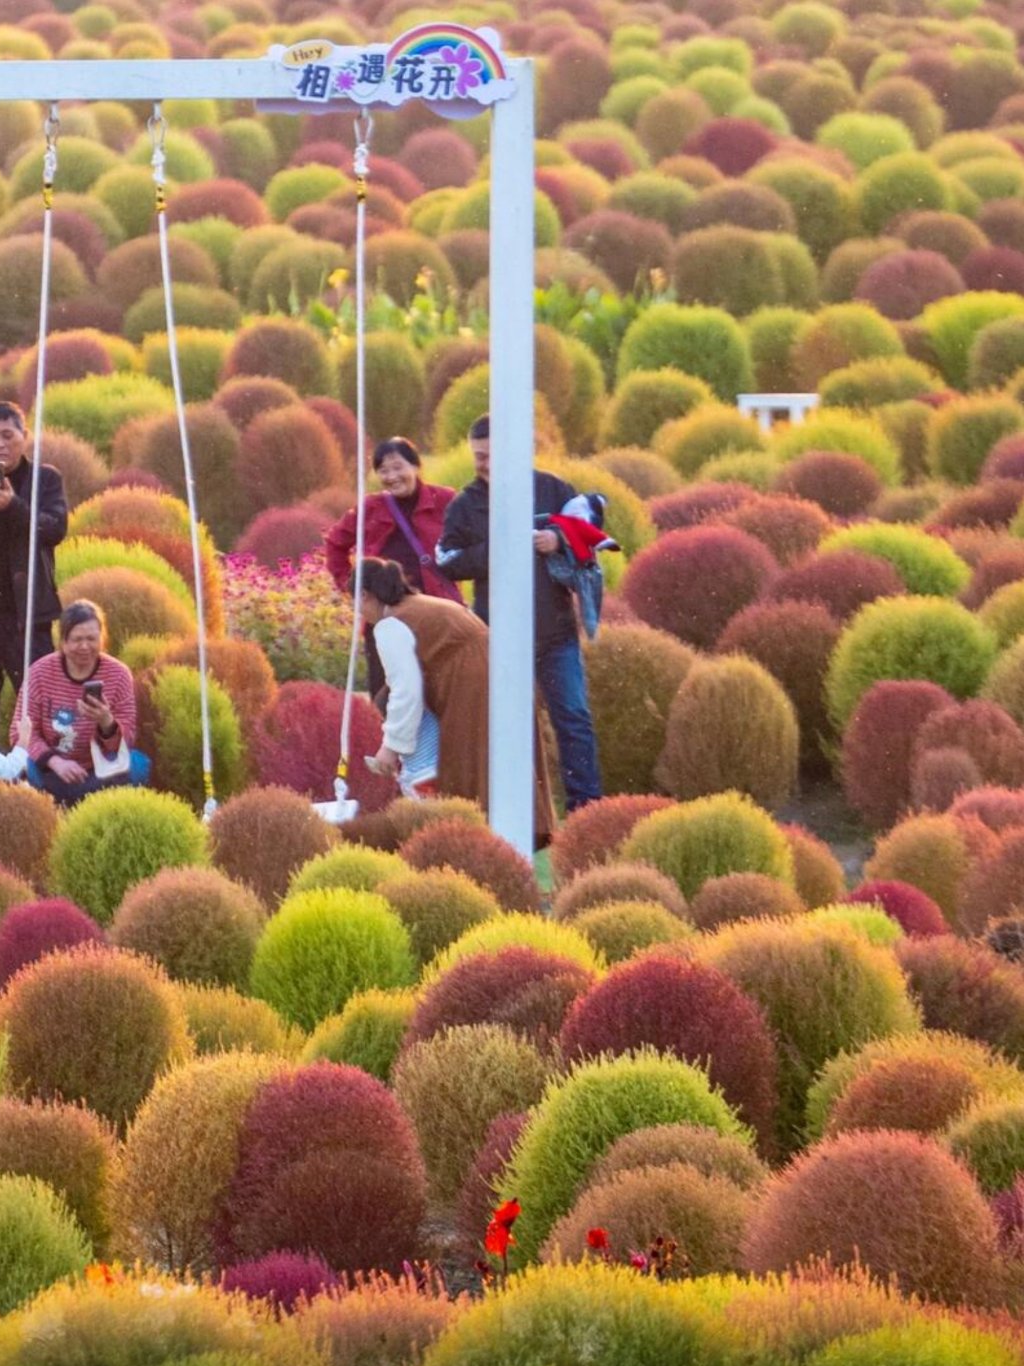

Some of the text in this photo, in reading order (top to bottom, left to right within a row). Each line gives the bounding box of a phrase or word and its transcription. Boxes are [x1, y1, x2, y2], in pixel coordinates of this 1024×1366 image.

[292, 46, 324, 63] Hey
[296, 53, 456, 98] 相遇花开
